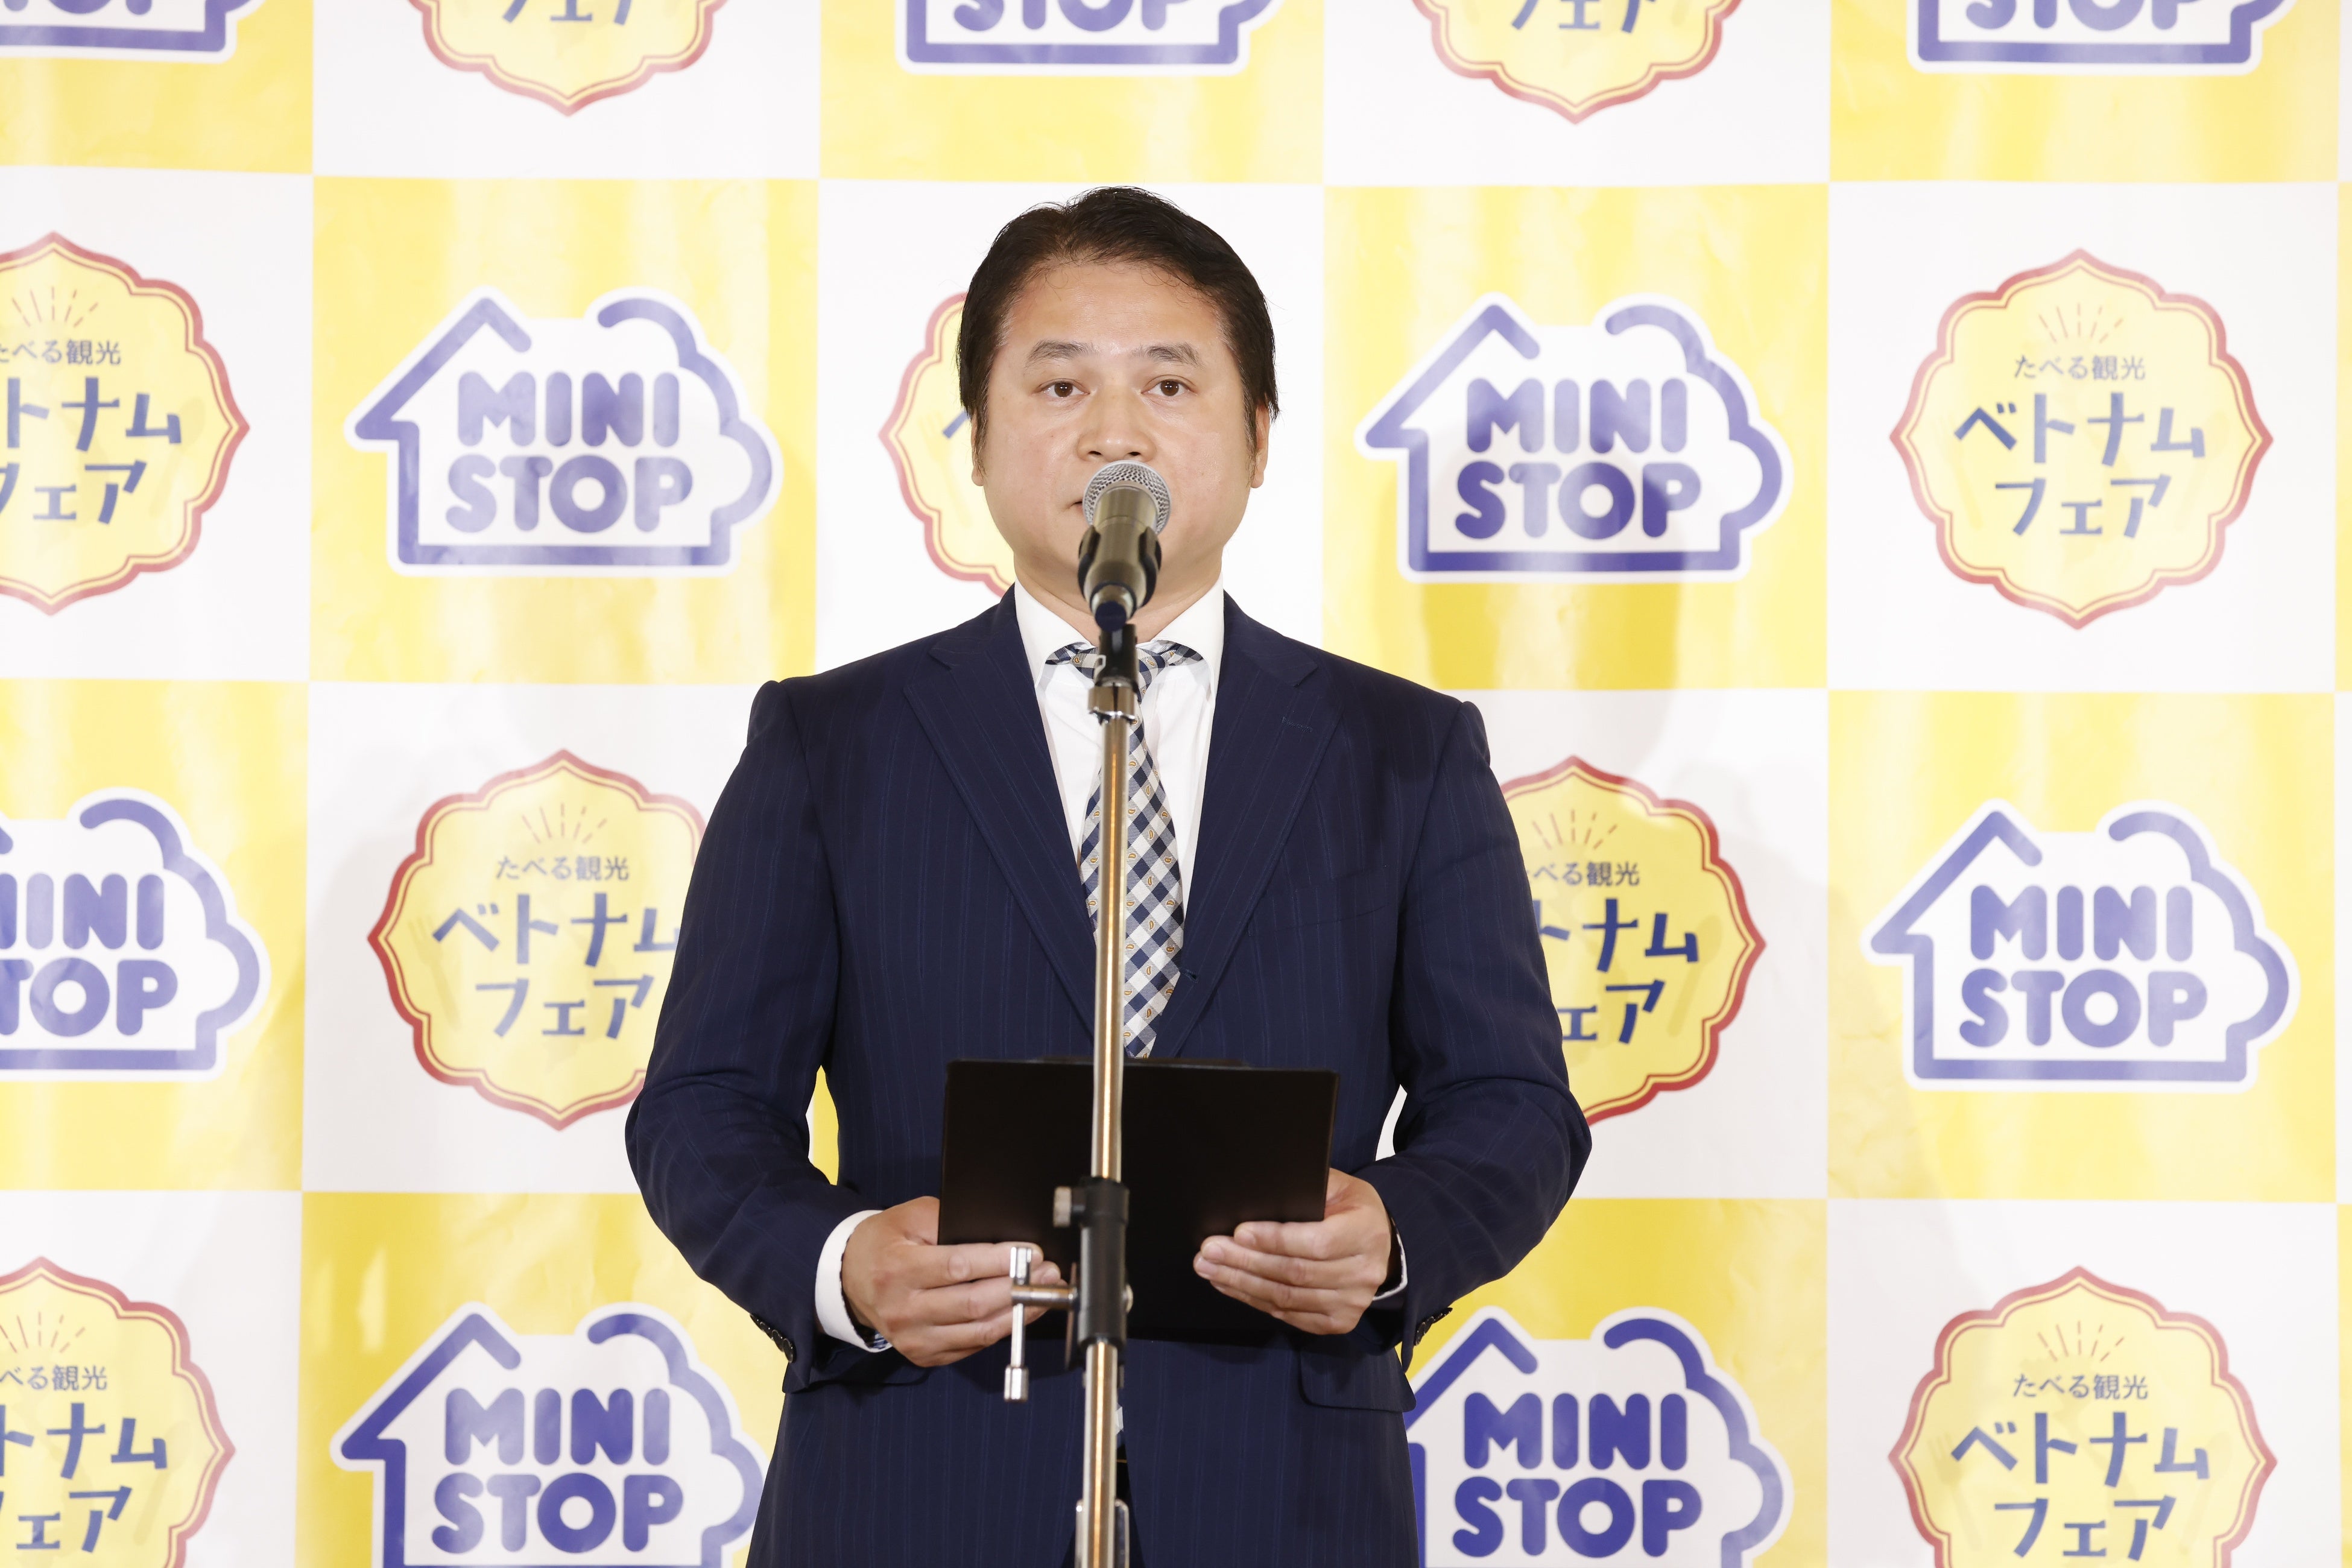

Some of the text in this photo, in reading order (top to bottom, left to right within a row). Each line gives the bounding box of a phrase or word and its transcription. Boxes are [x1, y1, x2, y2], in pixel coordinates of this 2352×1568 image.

[2013, 353, 2146, 382] たべる観光
[458, 371, 679, 447] MINI
[1467, 378, 1687, 454] MINI
[1953, 392, 2205, 467] ベトナム
[446, 454, 693, 533] STOP
[1455, 461, 1701, 540] STOP
[1995, 474, 2171, 538] フェア
[495, 855, 630, 882] たべる観光
[1526, 861, 1640, 887] べる観光
[0, 873, 165, 950] INI
[1970, 885, 2193, 961] MINI
[475, 974, 655, 1040] フェア
[1959, 968, 2207, 1048] STOP
[2012, 1372, 2149, 1402] たべる観光
[444, 1388, 671, 1465] MINI
[1464, 1392, 1687, 1471] MINI
[1950, 1411, 2210, 1487] ベトナム
[0, 1485, 133, 1554] ェア
[431, 1472, 683, 1554] STOP
[1452, 1476, 1702, 1558] STOP
[1994, 1495, 2177, 1562] フェア
